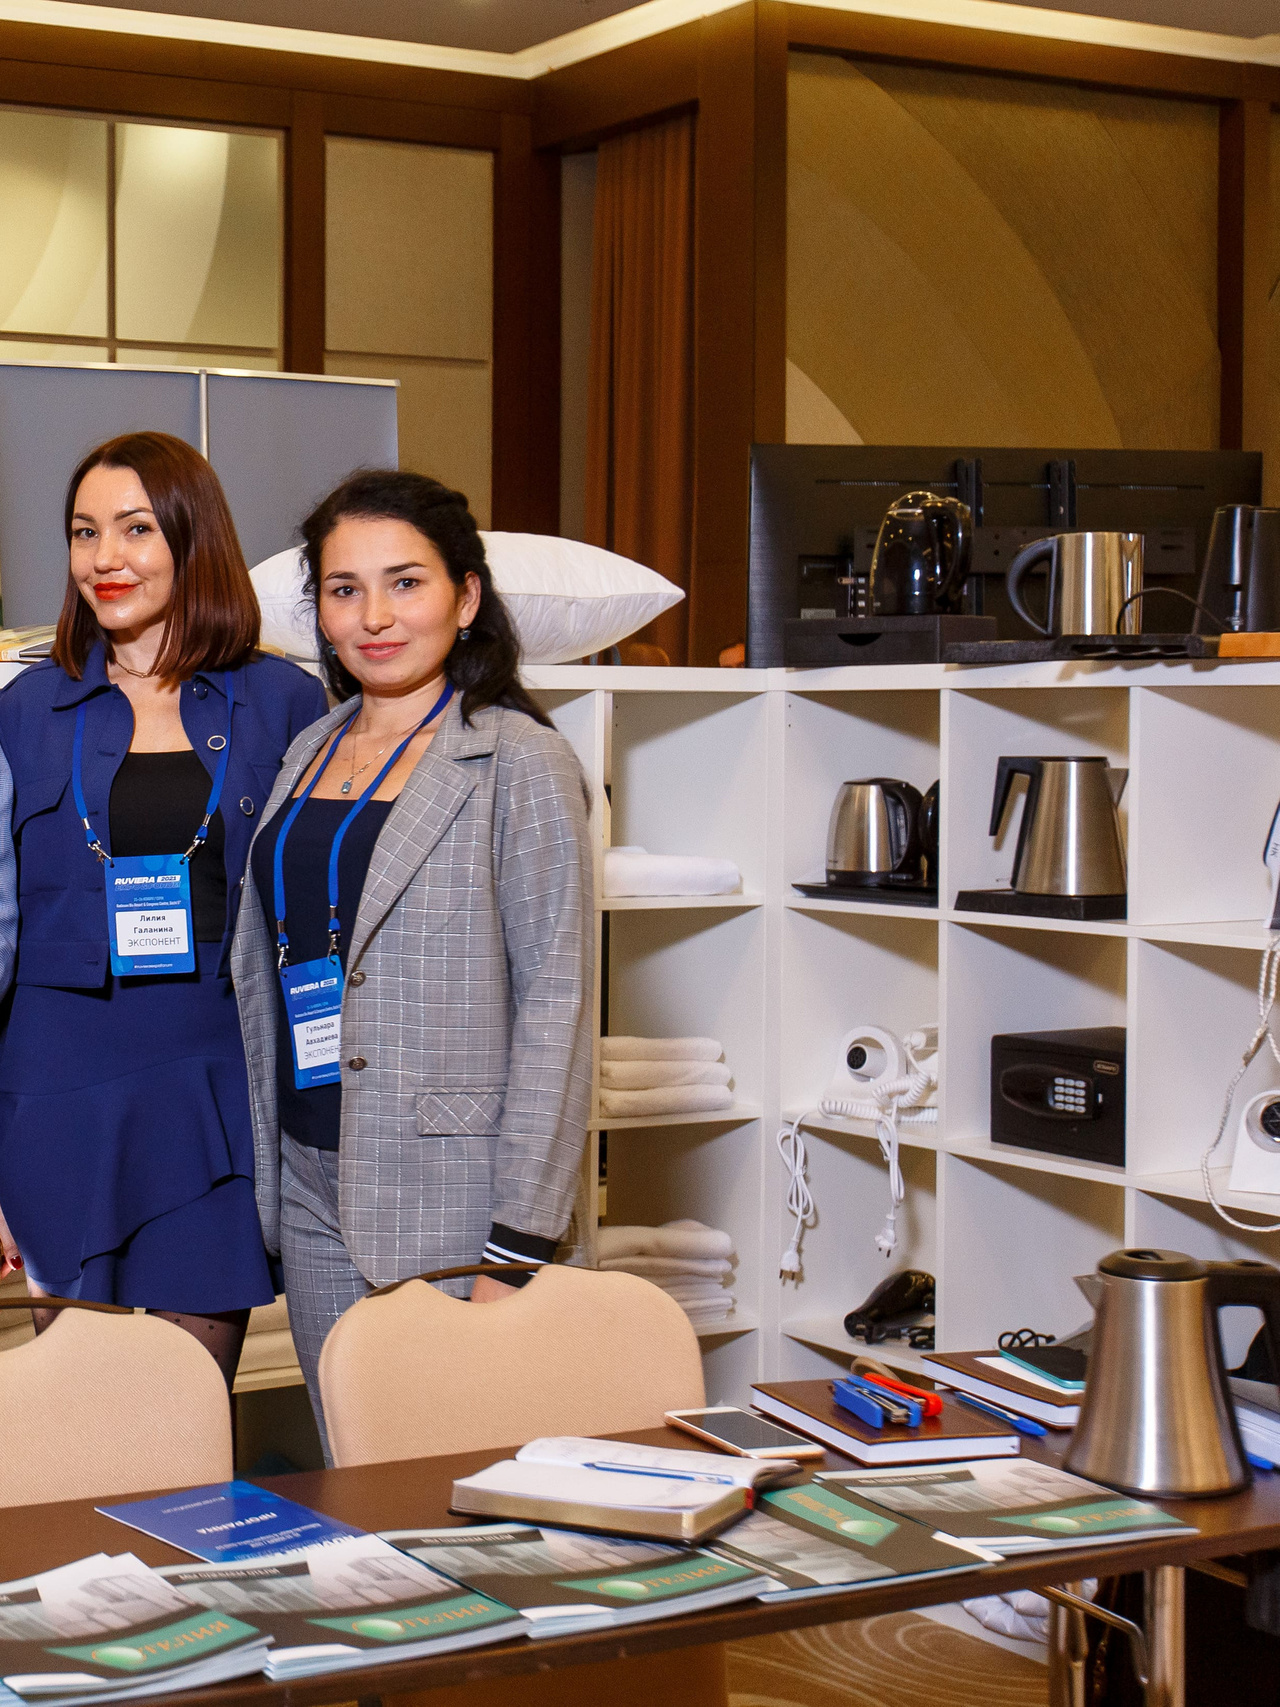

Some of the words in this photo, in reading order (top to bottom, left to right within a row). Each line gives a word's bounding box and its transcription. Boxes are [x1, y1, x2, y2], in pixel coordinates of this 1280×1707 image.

[114, 876, 155, 885] RUVIERA
[133, 926, 173, 934] Галанина
[127, 937, 181, 947] ЭКСПОНЕНТ
[290, 981, 320, 995] RUVIERA
[304, 1044, 340, 1060] ЭКСПОНЕН
